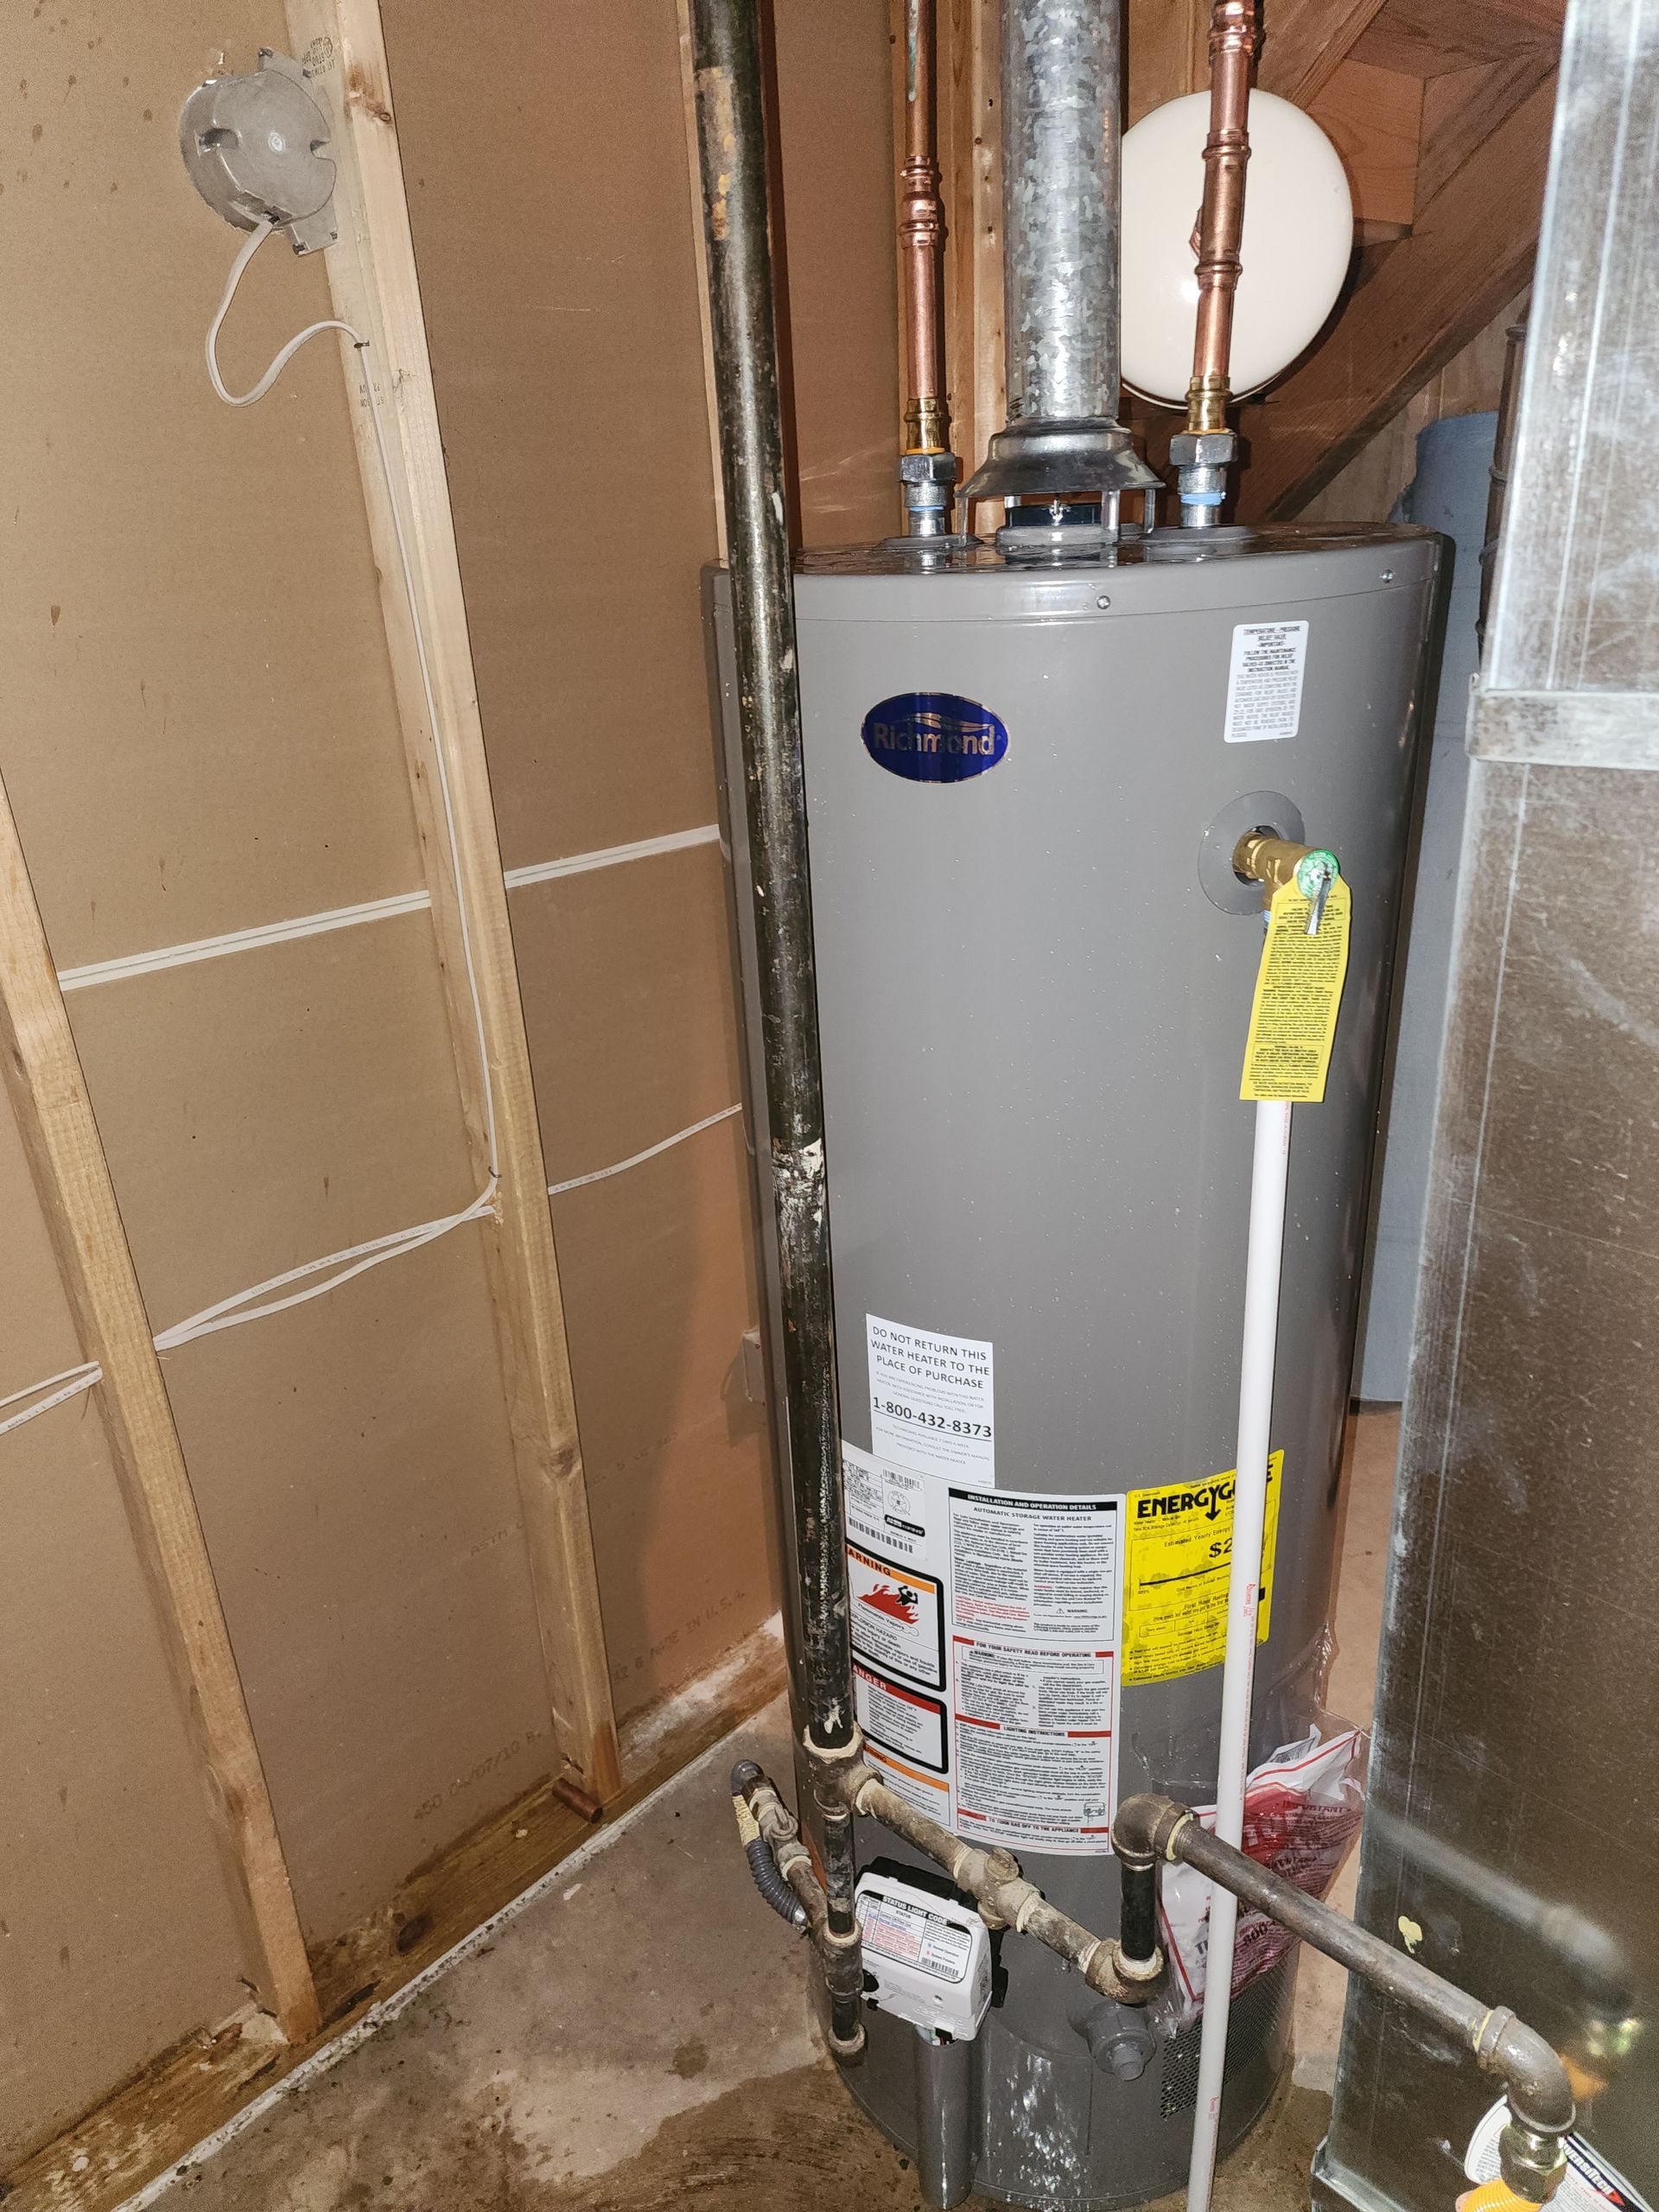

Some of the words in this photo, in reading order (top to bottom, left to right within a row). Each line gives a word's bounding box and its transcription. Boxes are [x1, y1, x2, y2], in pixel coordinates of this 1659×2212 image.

[873, 722, 995, 755] Richmond
[871, 1338, 904, 1357] WATER
[907, 1351, 947, 1368] HEATER
[950, 1361, 964, 1371] TO
[968, 1364, 990, 1376] THE
[873, 1326, 887, 1338] DO
[890, 1332, 911, 1344] NOT
[914, 1338, 957, 1356] RETURN
[961, 1349, 987, 1361] THIS
[877, 1355, 906, 1371] PLACE
[909, 1365, 922, 1376] OF
[925, 1370, 983, 1389] PURCHASE
[874, 1396, 992, 1437] 1-800-432-8373
[968, 1494, 1013, 1507] INSTALLATION
[974, 1507, 1010, 1517] AUTOMATIC
[1194, 1532, 1211, 1541] Yearly
[1213, 1526, 1231, 1537] Energy
[845, 1544, 891, 1576] ARNING
[851, 1612, 874, 1630] XPLOSION
[876, 1628, 897, 1641] HAZARD
[850, 1663, 887, 1691] ANGER
[882, 1896, 906, 1910] STATUS
[907, 1905, 927, 1918] LIGHT
[928, 1913, 948, 1925] CODE
[896, 1910, 912, 1919] STATUS
[1560, 2141, 1615, 2196] IVERSITECH
